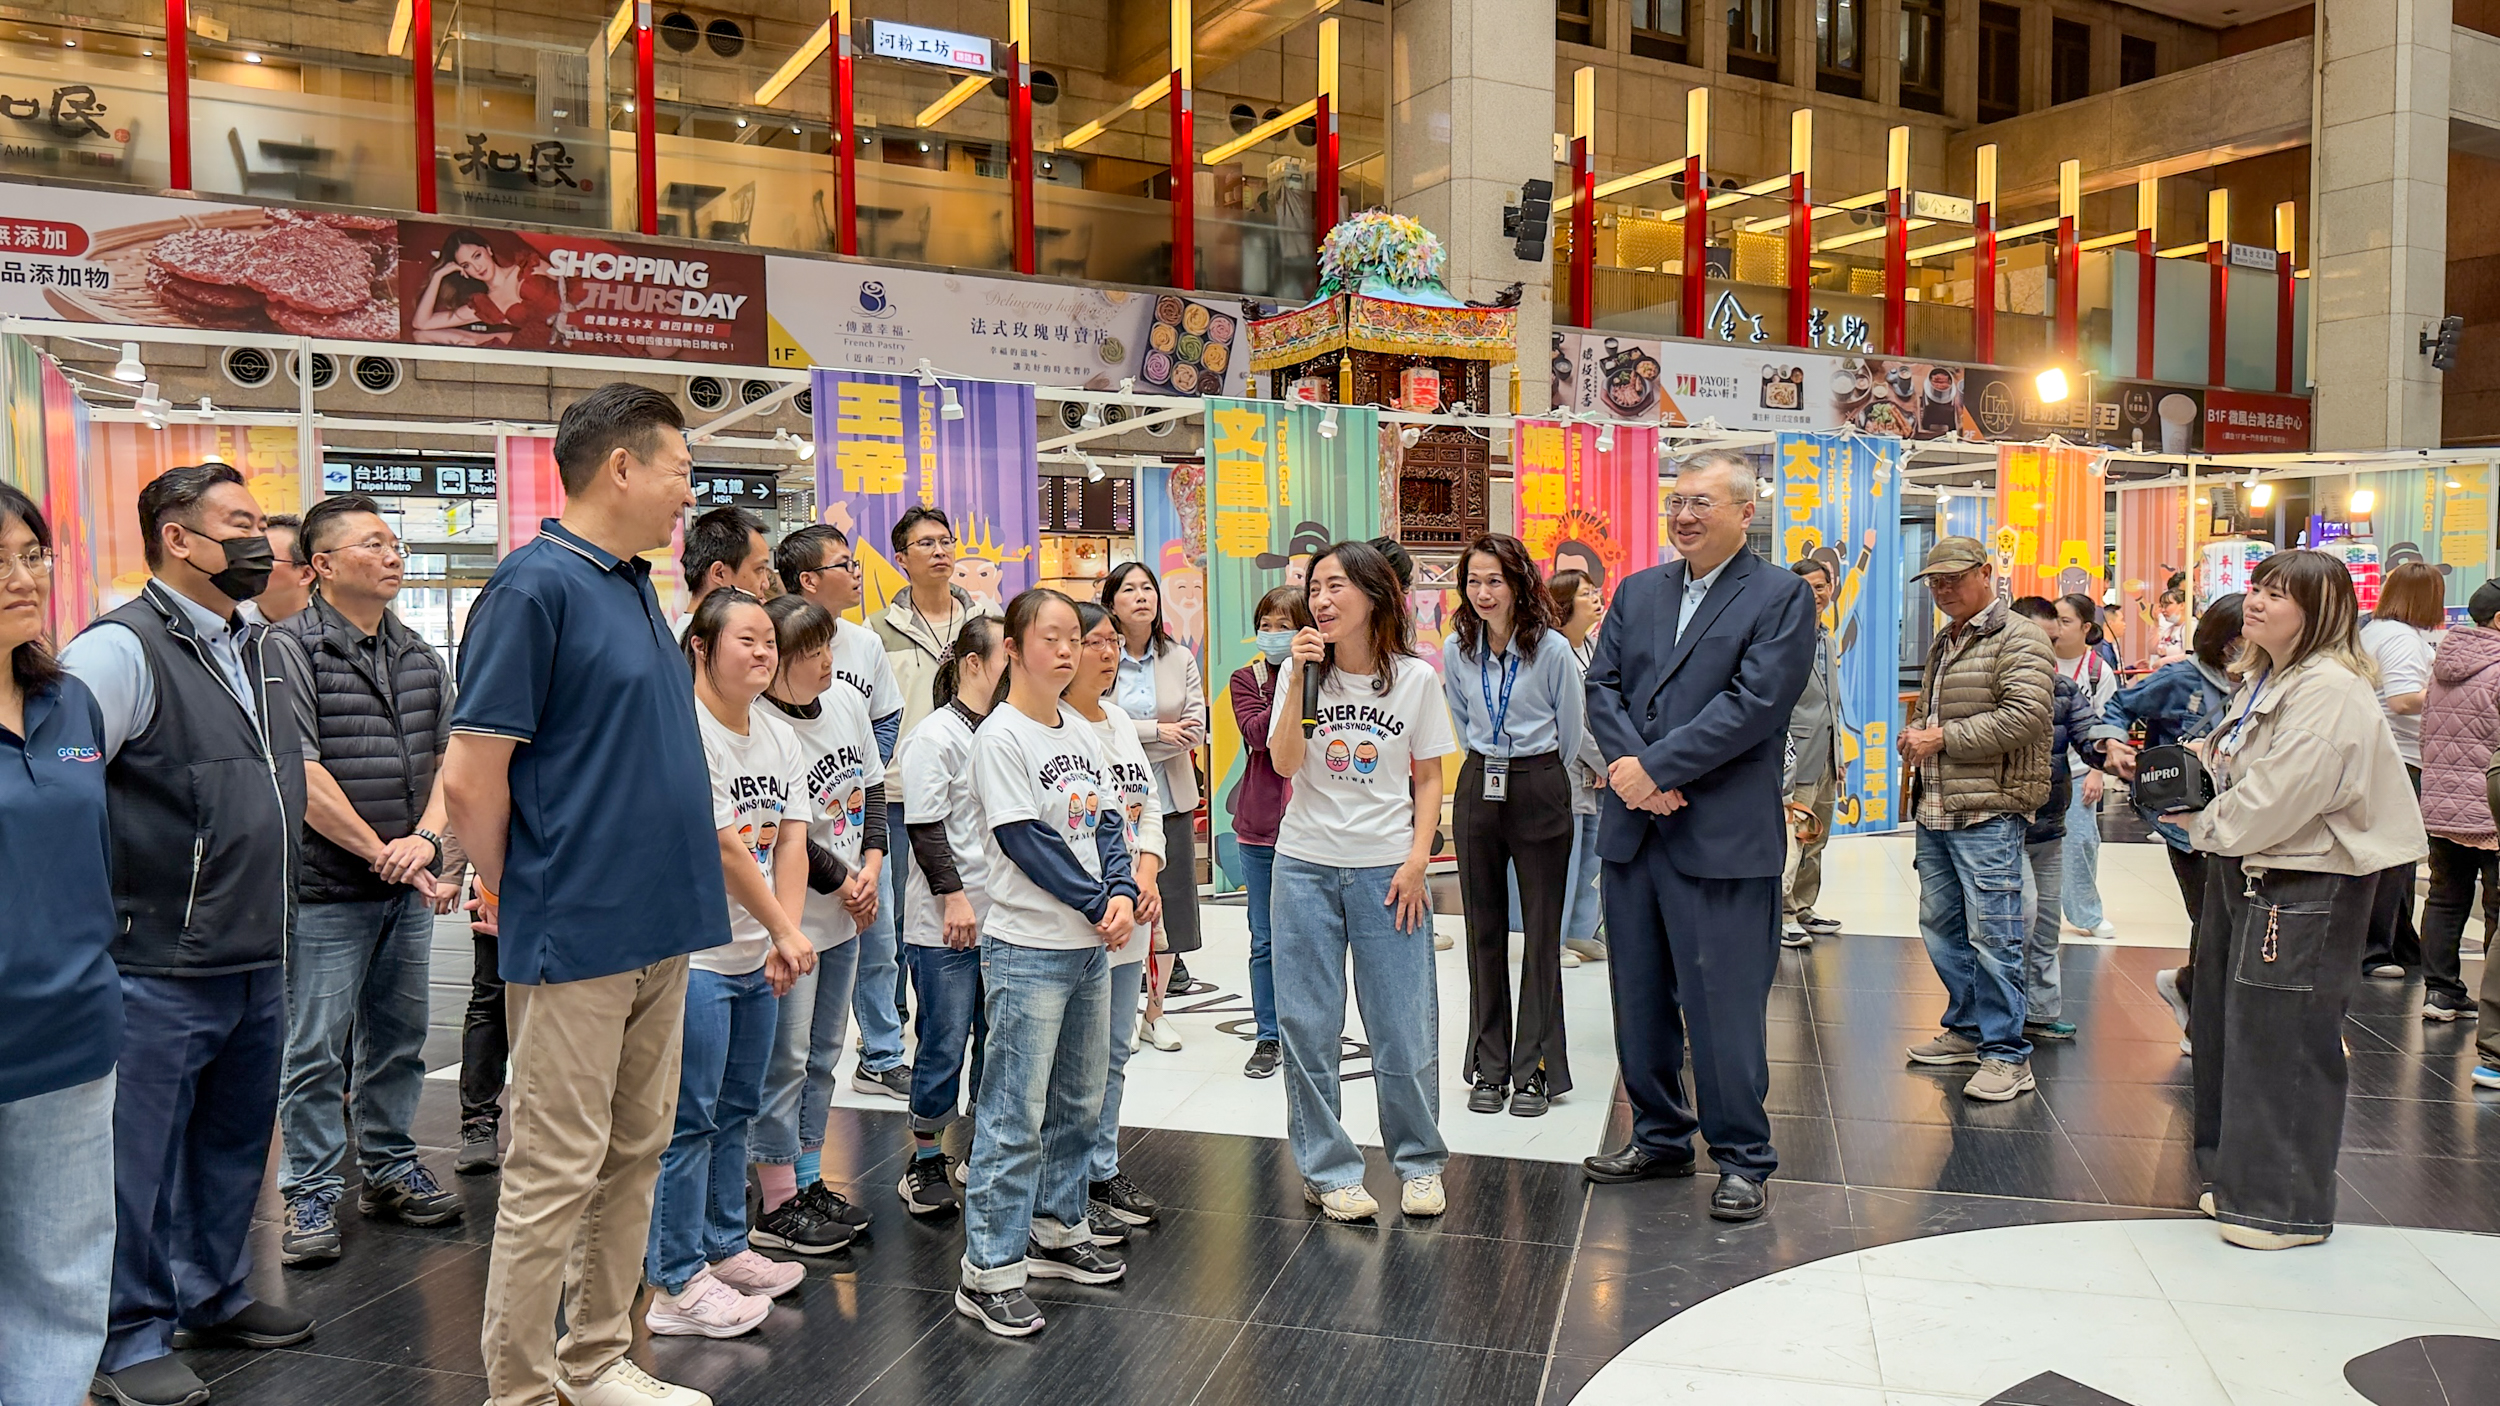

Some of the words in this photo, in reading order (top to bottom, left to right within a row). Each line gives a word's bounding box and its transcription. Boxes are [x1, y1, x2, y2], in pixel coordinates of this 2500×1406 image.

[879, 31, 950, 58] 河粉工坊
[453, 132, 578, 188] 和民
[462, 190, 518, 207] WATAMI
[1, 261, 110, 289] 品添加物
[547, 248, 709, 289] SHOPPING
[581, 281, 748, 320] THURSDAY
[846, 320, 904, 337] 傳遞幸福
[970, 317, 1109, 346] 法式玫瑰專賣店
[774, 347, 797, 361] 1F
[843, 338, 875, 349] French
[877, 342, 906, 351] Pastry
[1698, 375, 1726, 387] YAYOI
[1698, 386, 1730, 399] やよい軒
[918, 390, 936, 450] Jade
[1661, 411, 1676, 421] 2F
[2207, 409, 2227, 422] B1F
[2228, 410, 2303, 430] 微風台灣名產中心
[1277, 416, 1289, 463] Test
[1964, 430, 1976, 439] 2F
[1571, 432, 1582, 483] Mazu
[1841, 446, 1853, 493] Third
[354, 466, 422, 482] 台北捷運
[712, 479, 744, 494] 高鐵
[1212, 407, 1270, 558] 文昌君
[1278, 465, 1292, 507] God
[355, 482, 383, 491] Taipei
[385, 483, 412, 492] Metro
[469, 486, 496, 495] Taipei
[713, 495, 733, 504] HSR
[2045, 491, 2055, 523] God
[2219, 555, 2233, 586] 平安
[836, 670, 873, 699] FALLS
[1316, 704, 1357, 726] EVER
[1359, 705, 1405, 736] FALLS
[1318, 722, 1389, 741] DOWN-SYNDROME
[57, 746, 95, 758] GGTCC
[1038, 754, 1075, 790] NEVER
[1330, 774, 1374, 785] TAIWAN
[1863, 721, 1887, 823] 行車平安
